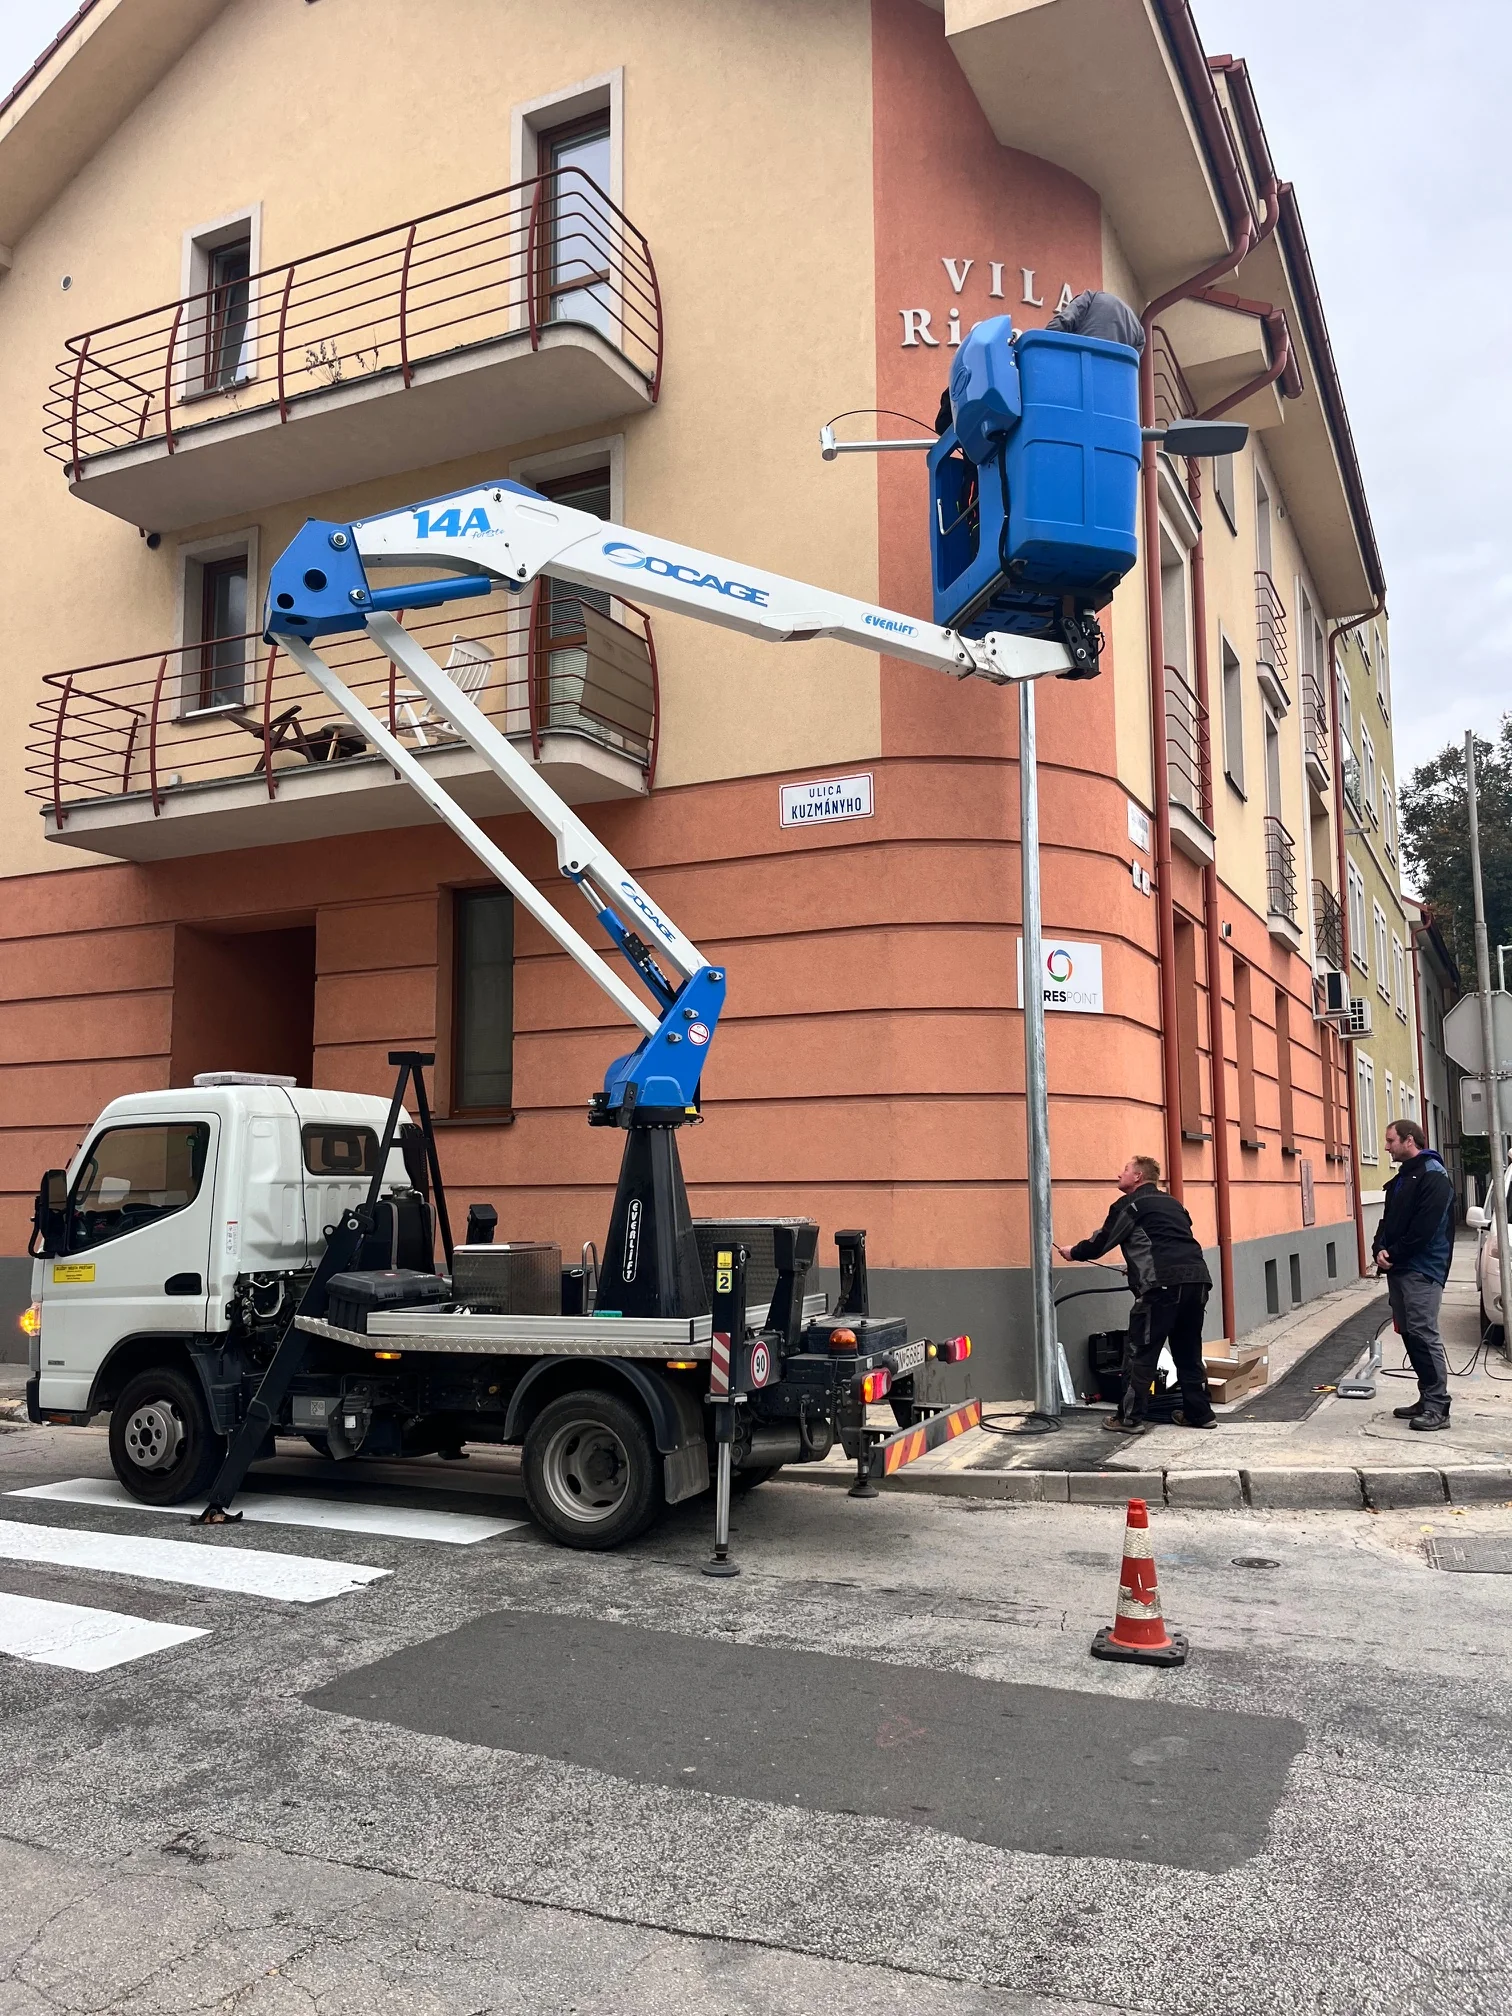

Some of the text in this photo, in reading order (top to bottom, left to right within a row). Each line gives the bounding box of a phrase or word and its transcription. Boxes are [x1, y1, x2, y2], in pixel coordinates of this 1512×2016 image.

[941, 257, 1075, 314] VILA
[413, 507, 491, 539] 14A
[601, 542, 770, 608] SOCAGE
[809, 784, 842, 798] ULICA
[791, 797, 862, 820] KUZMÁNYHO
[621, 881, 676, 943] SOCAGE
[719, 1276, 730, 1290] 2
[756, 1355, 766, 1374] 90
